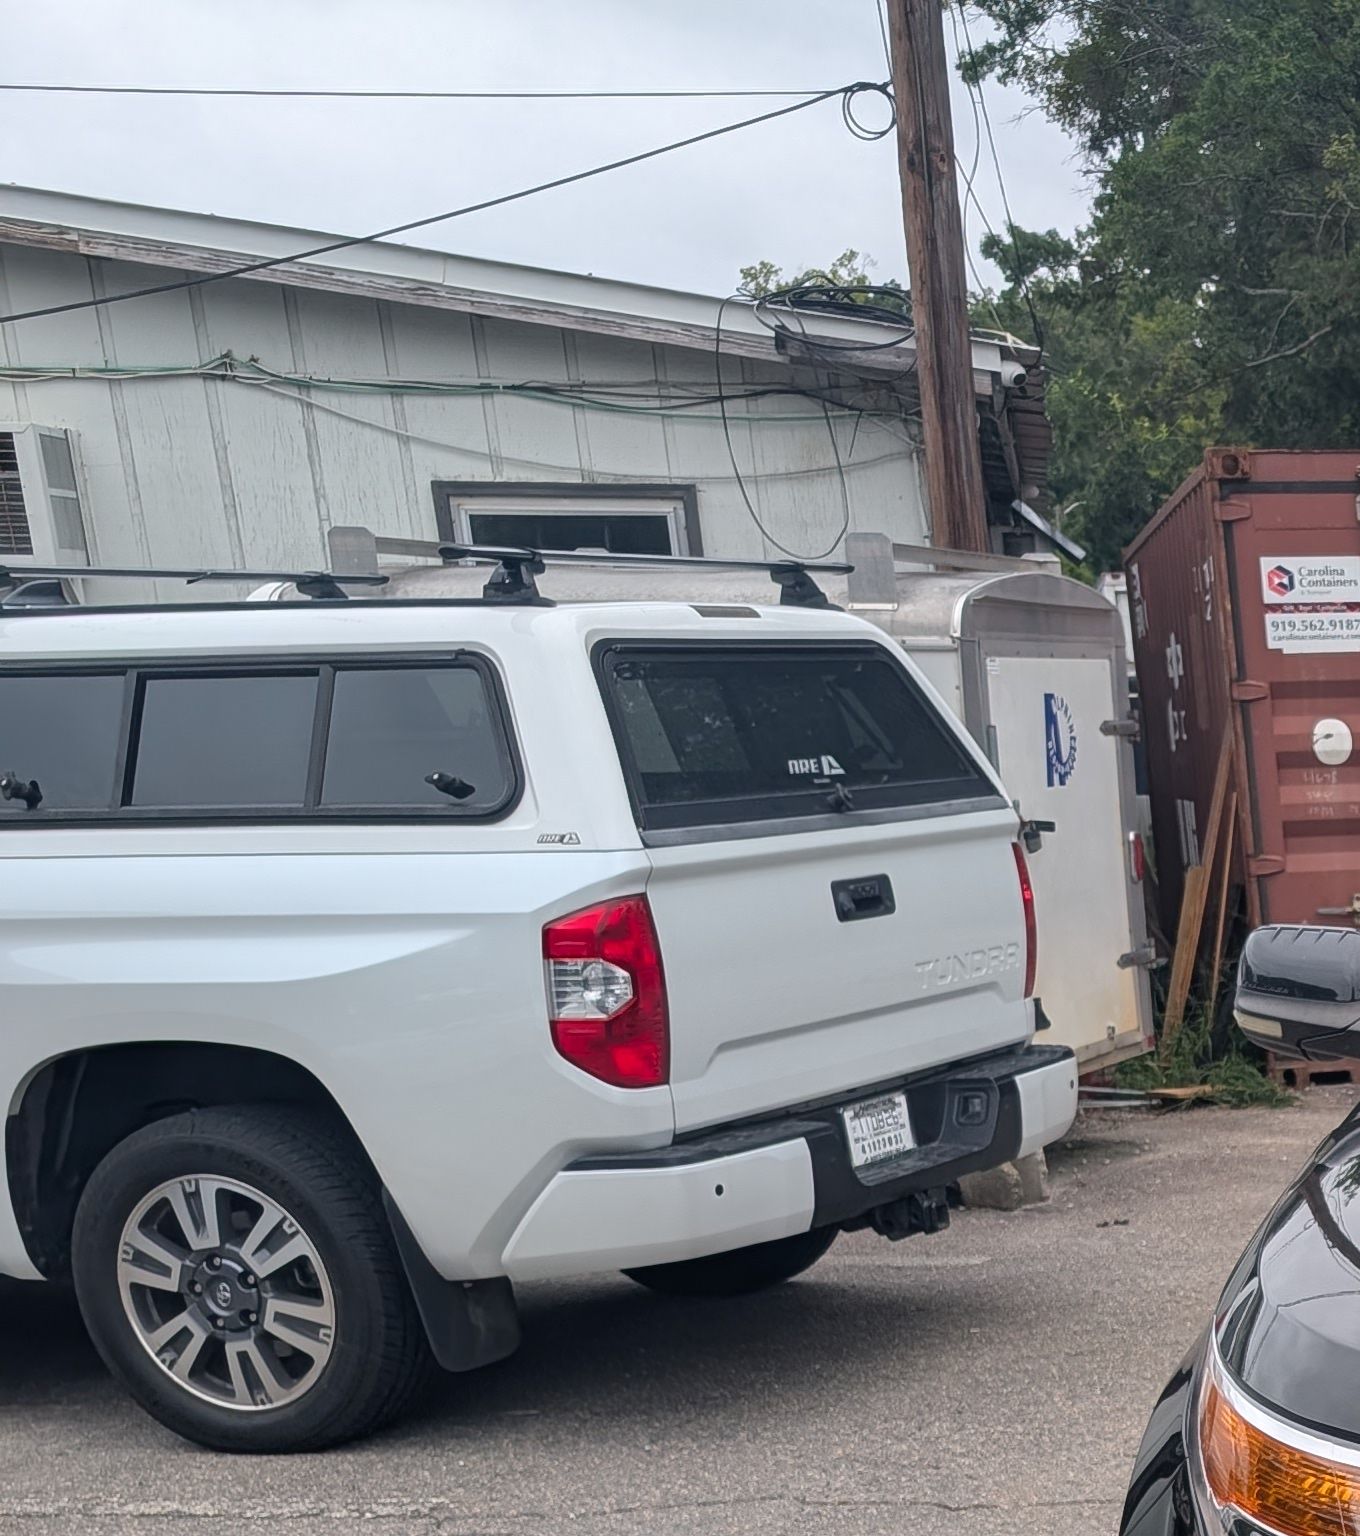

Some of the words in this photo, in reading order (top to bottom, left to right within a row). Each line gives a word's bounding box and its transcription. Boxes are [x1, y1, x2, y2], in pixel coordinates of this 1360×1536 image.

[1298, 565, 1345, 577] Carolina
[1299, 577, 1359, 588] Containers
[914, 942, 1020, 990] TUNDRA
